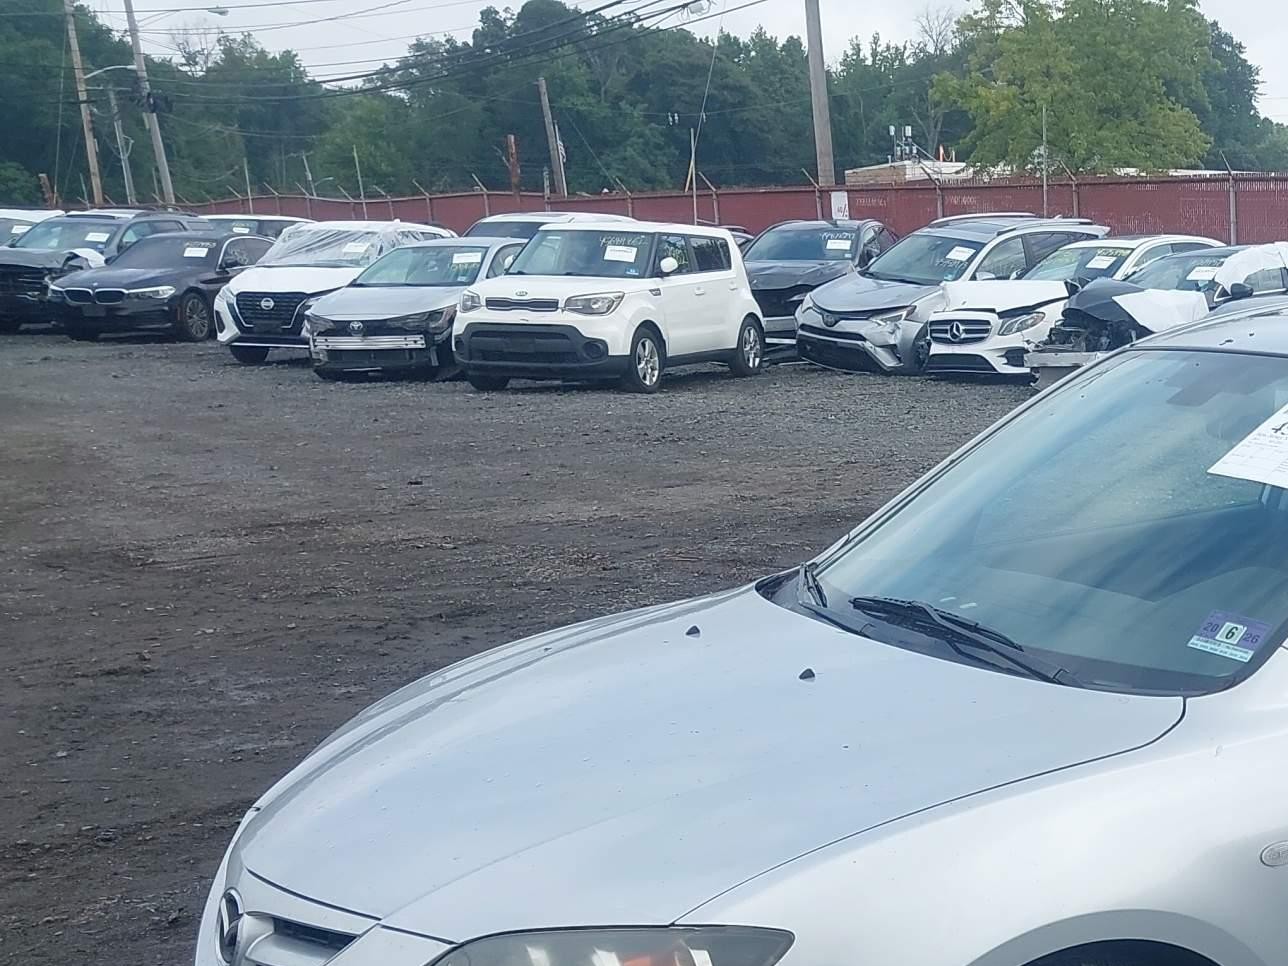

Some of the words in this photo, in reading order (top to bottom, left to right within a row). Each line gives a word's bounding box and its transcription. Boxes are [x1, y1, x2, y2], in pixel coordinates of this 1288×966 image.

[1202, 622, 1220, 633] 20
[1225, 625, 1239, 640] 6
[1242, 632, 1261, 644] 26
